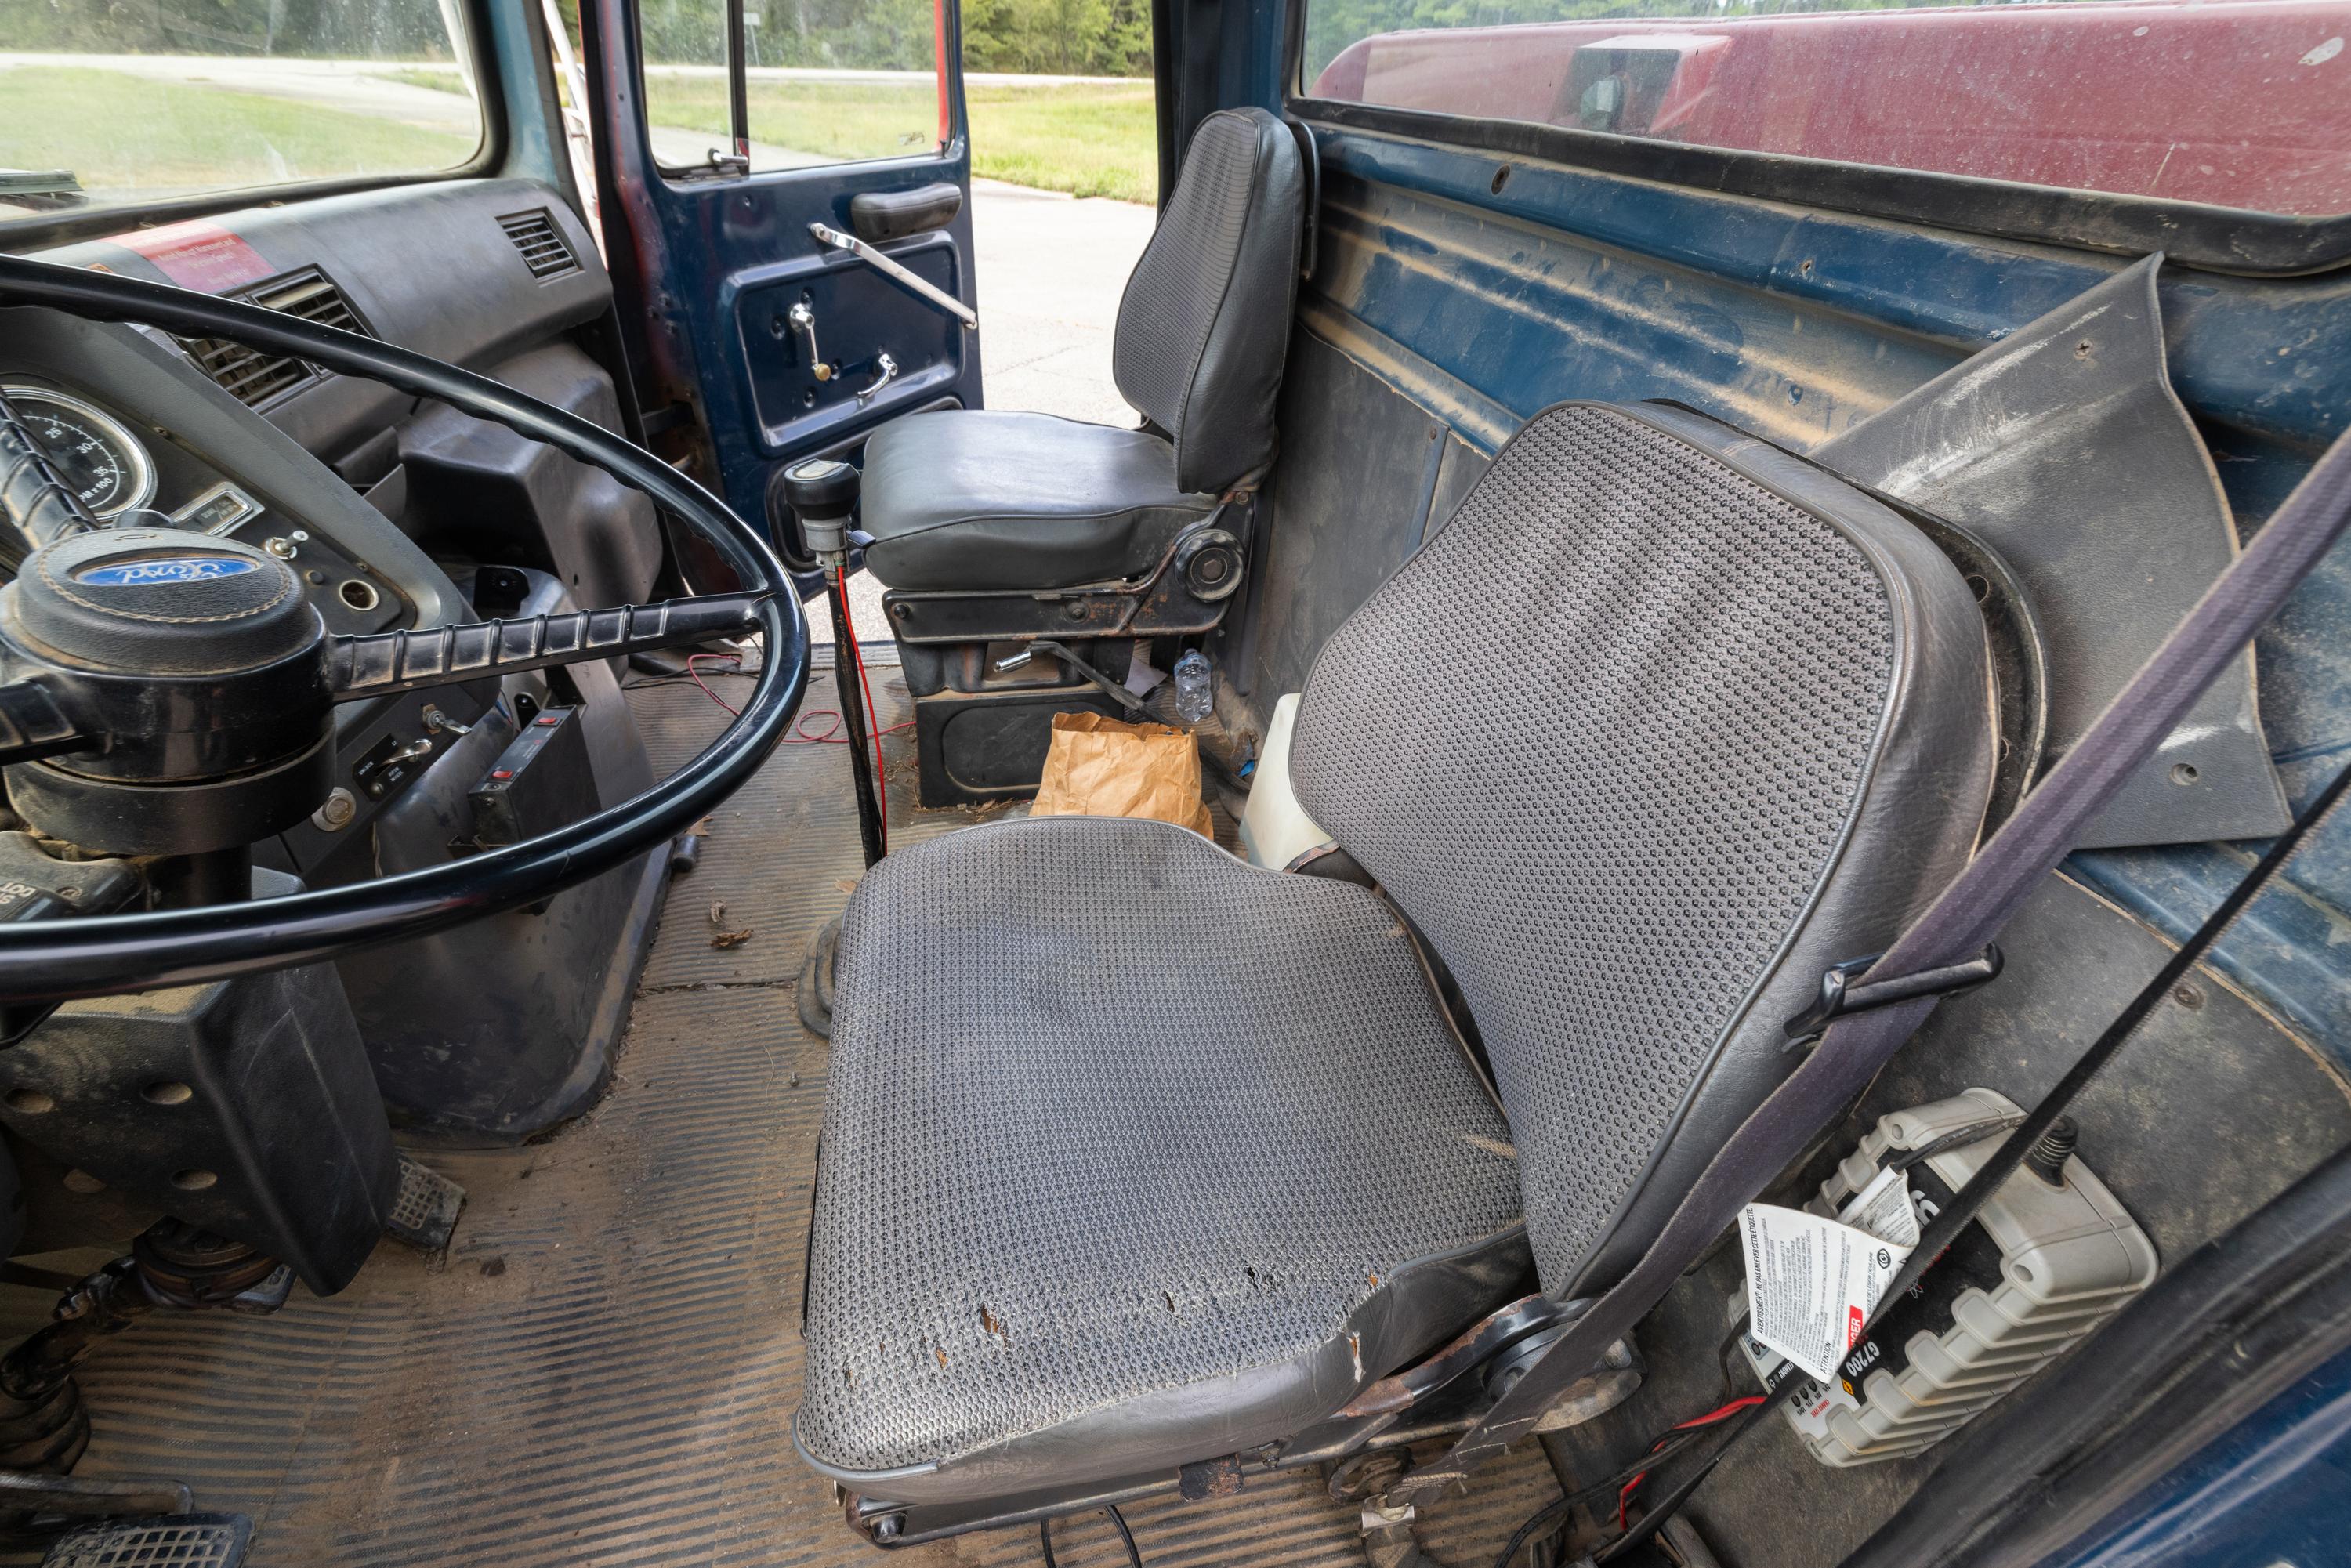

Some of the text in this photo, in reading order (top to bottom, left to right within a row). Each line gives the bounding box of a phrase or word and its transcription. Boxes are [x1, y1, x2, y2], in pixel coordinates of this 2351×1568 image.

[45, 427, 63, 439] 25
[76, 443, 93, 454] 30
[92, 465, 110, 477] 35
[99, 477, 114, 489] 100
[116, 562, 226, 584] Ford
[1752, 1248, 1761, 1271] ENLEVER
[1846, 1341, 1880, 1377] G7200
